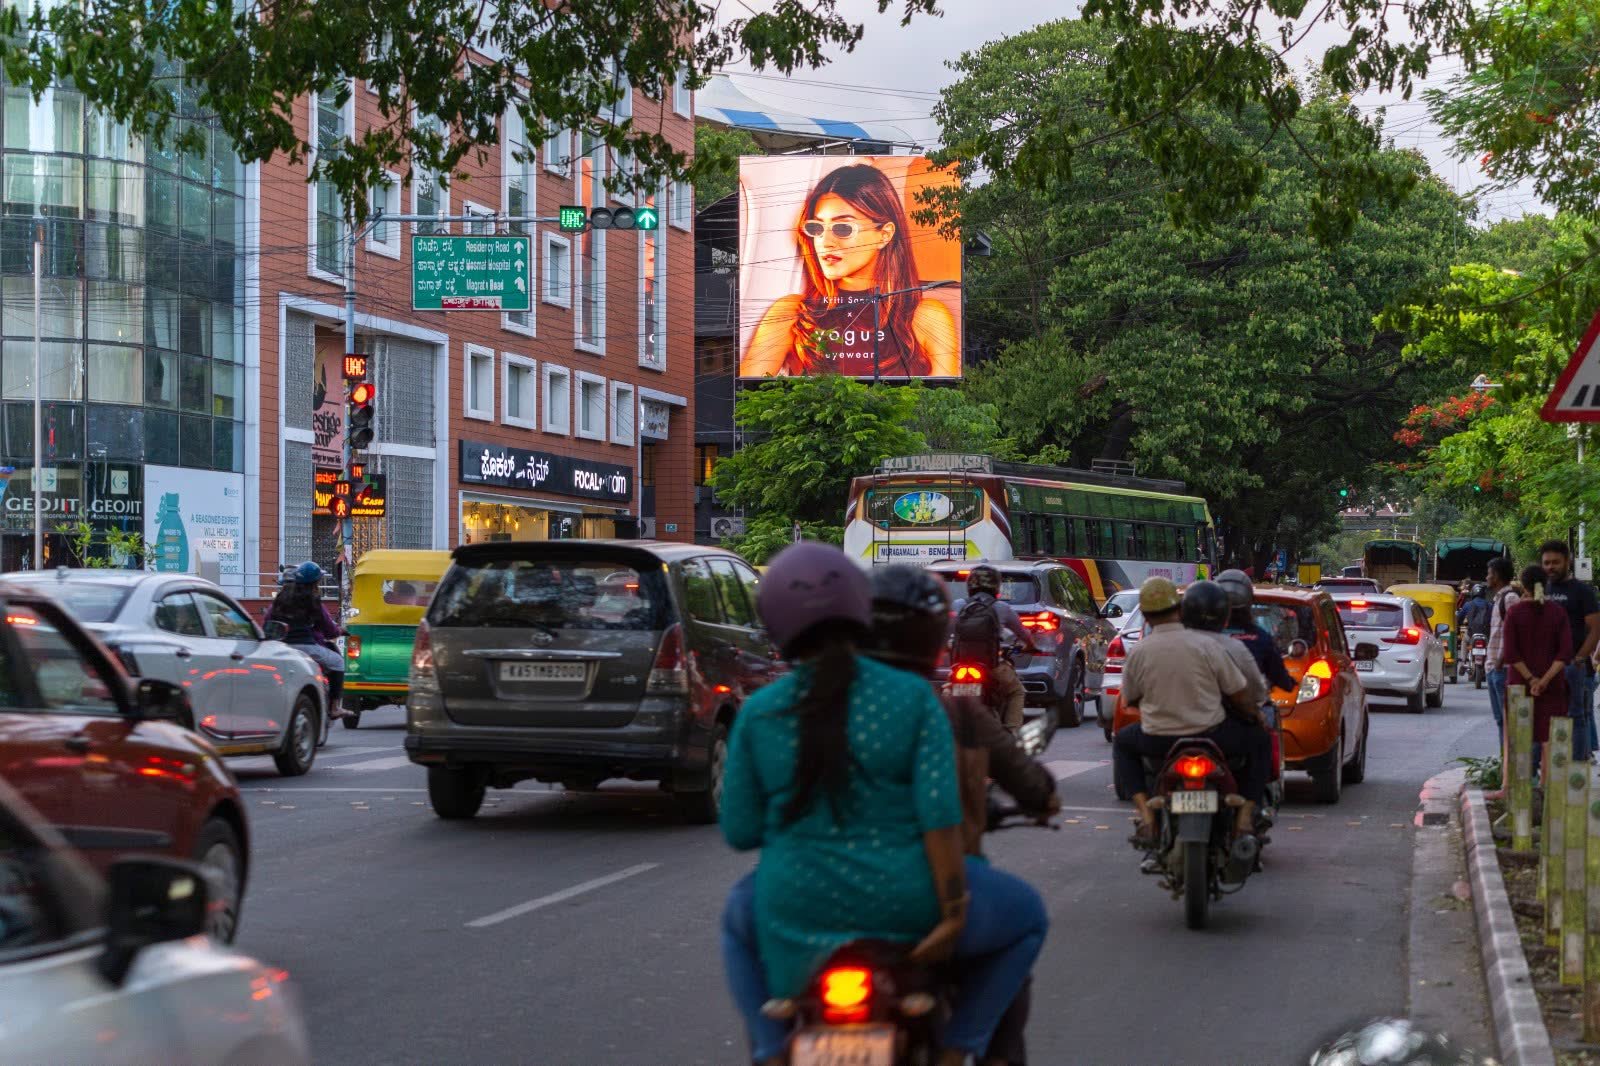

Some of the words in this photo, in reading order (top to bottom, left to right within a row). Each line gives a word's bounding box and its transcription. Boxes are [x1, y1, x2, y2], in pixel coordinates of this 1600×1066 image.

[495, 240, 510, 253] Road
[823, 296, 844, 304] Kriti
[574, 470, 599, 490] FOCAL
[91, 499, 142, 514] GEOJIT
